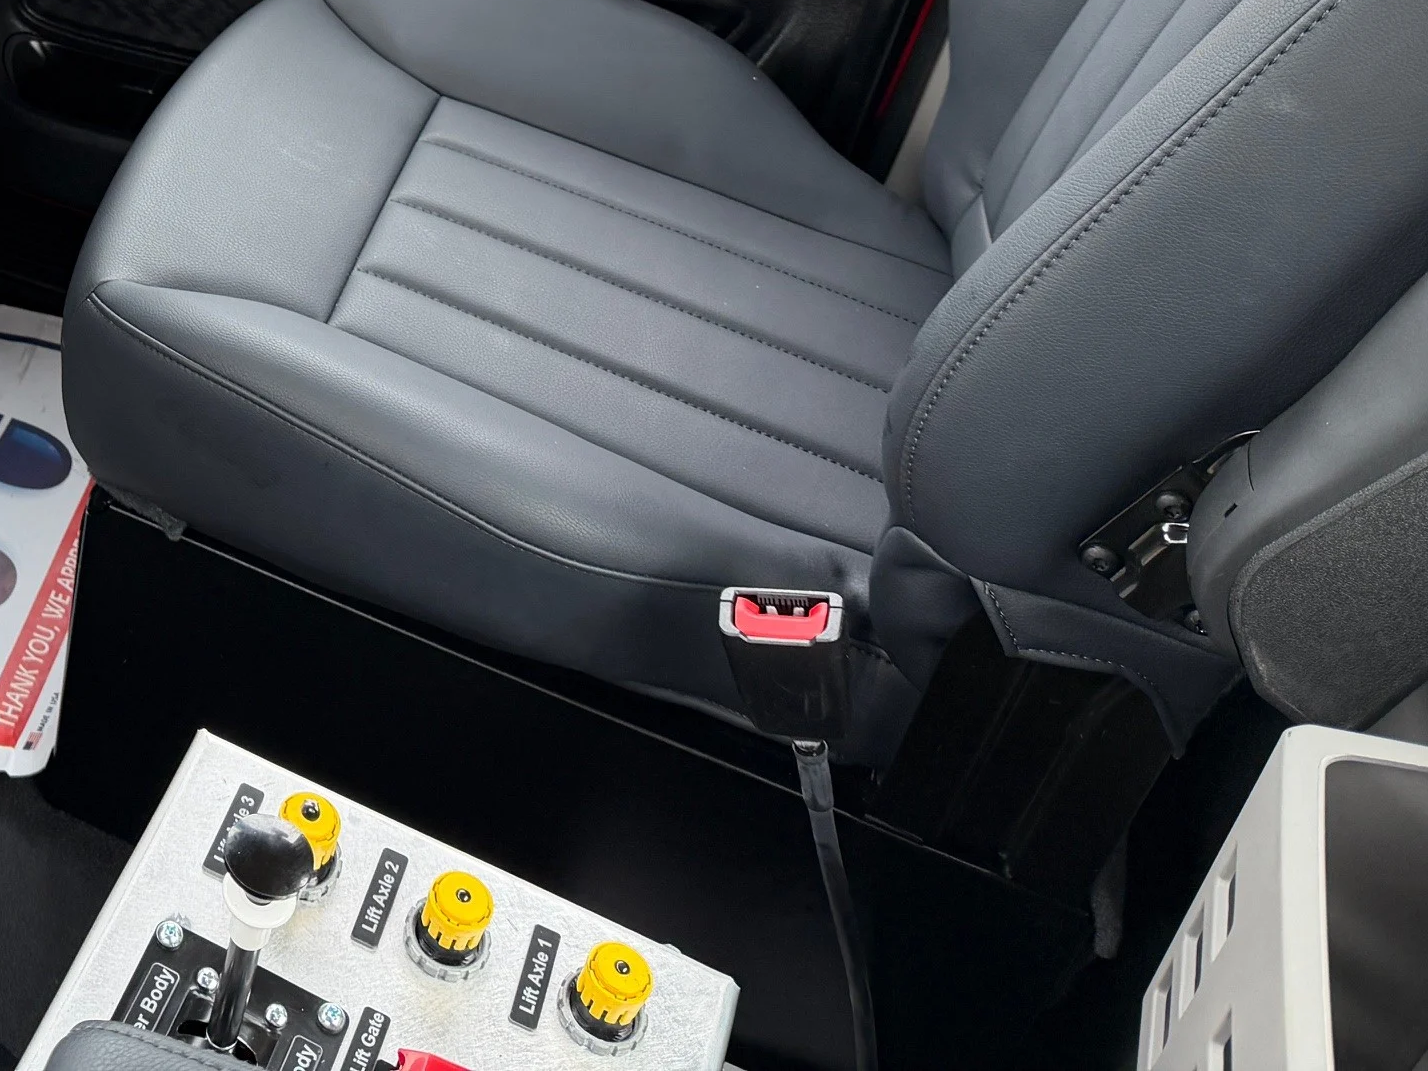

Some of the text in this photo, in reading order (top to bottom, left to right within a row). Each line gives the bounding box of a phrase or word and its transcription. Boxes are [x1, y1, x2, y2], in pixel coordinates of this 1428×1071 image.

[22, 624, 60, 666] YOU,
[41, 589, 71, 619] WE
[241, 795, 255, 807] 3
[361, 860, 400, 934] Lift Axle 2
[139, 968, 175, 1014] Body
[519, 938, 553, 1015] Lift Axle 1
[360, 1012, 385, 1048] Gate
